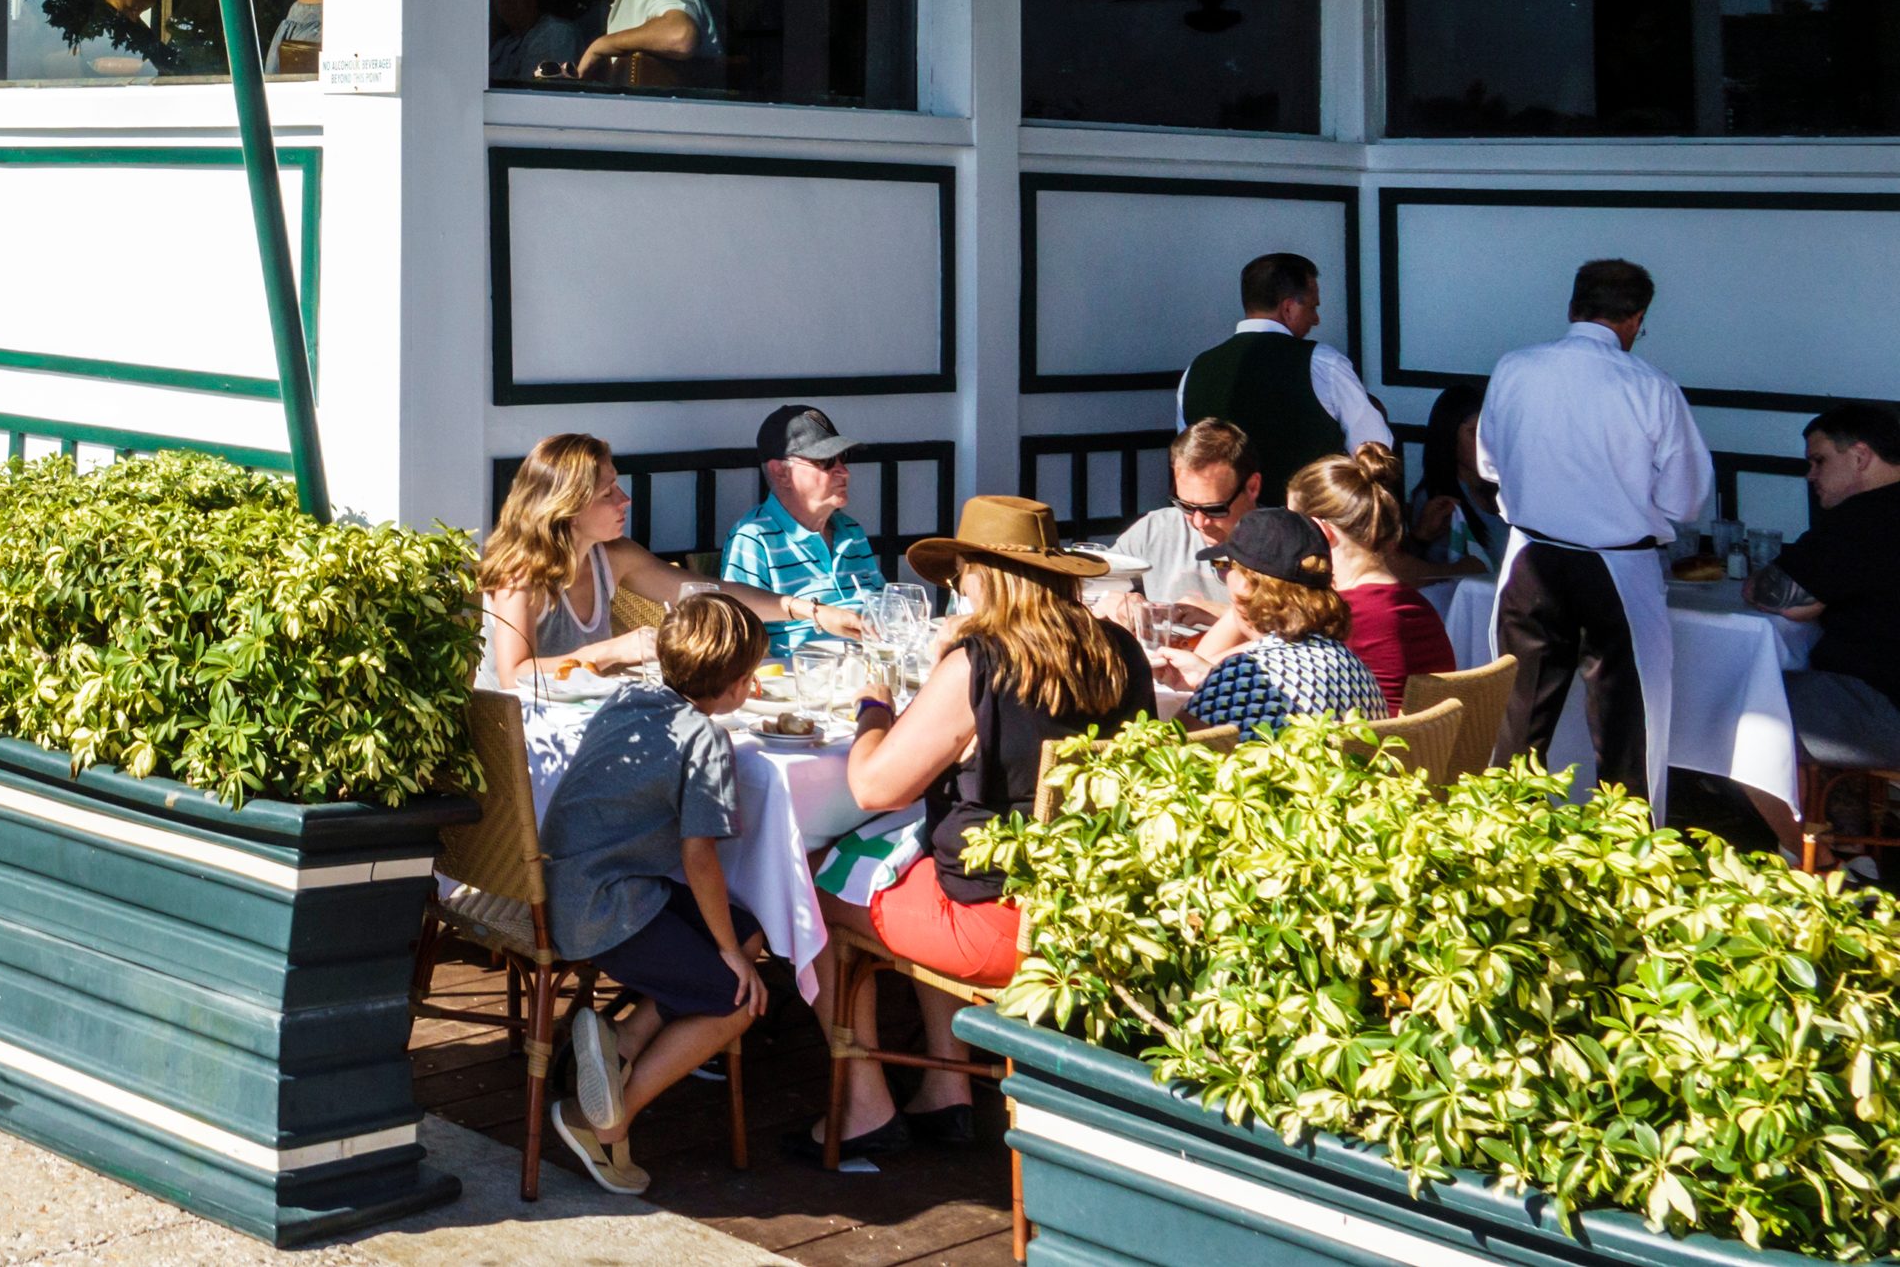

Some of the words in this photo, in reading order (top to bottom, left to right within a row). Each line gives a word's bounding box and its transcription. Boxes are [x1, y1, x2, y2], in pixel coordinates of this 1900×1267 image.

[322, 61, 331, 71] NO
[362, 58, 392, 70] BEVERAGES
[331, 73, 352, 84] BEYOND
[353, 72, 365, 83] THIS
[366, 72, 382, 83] POINT
